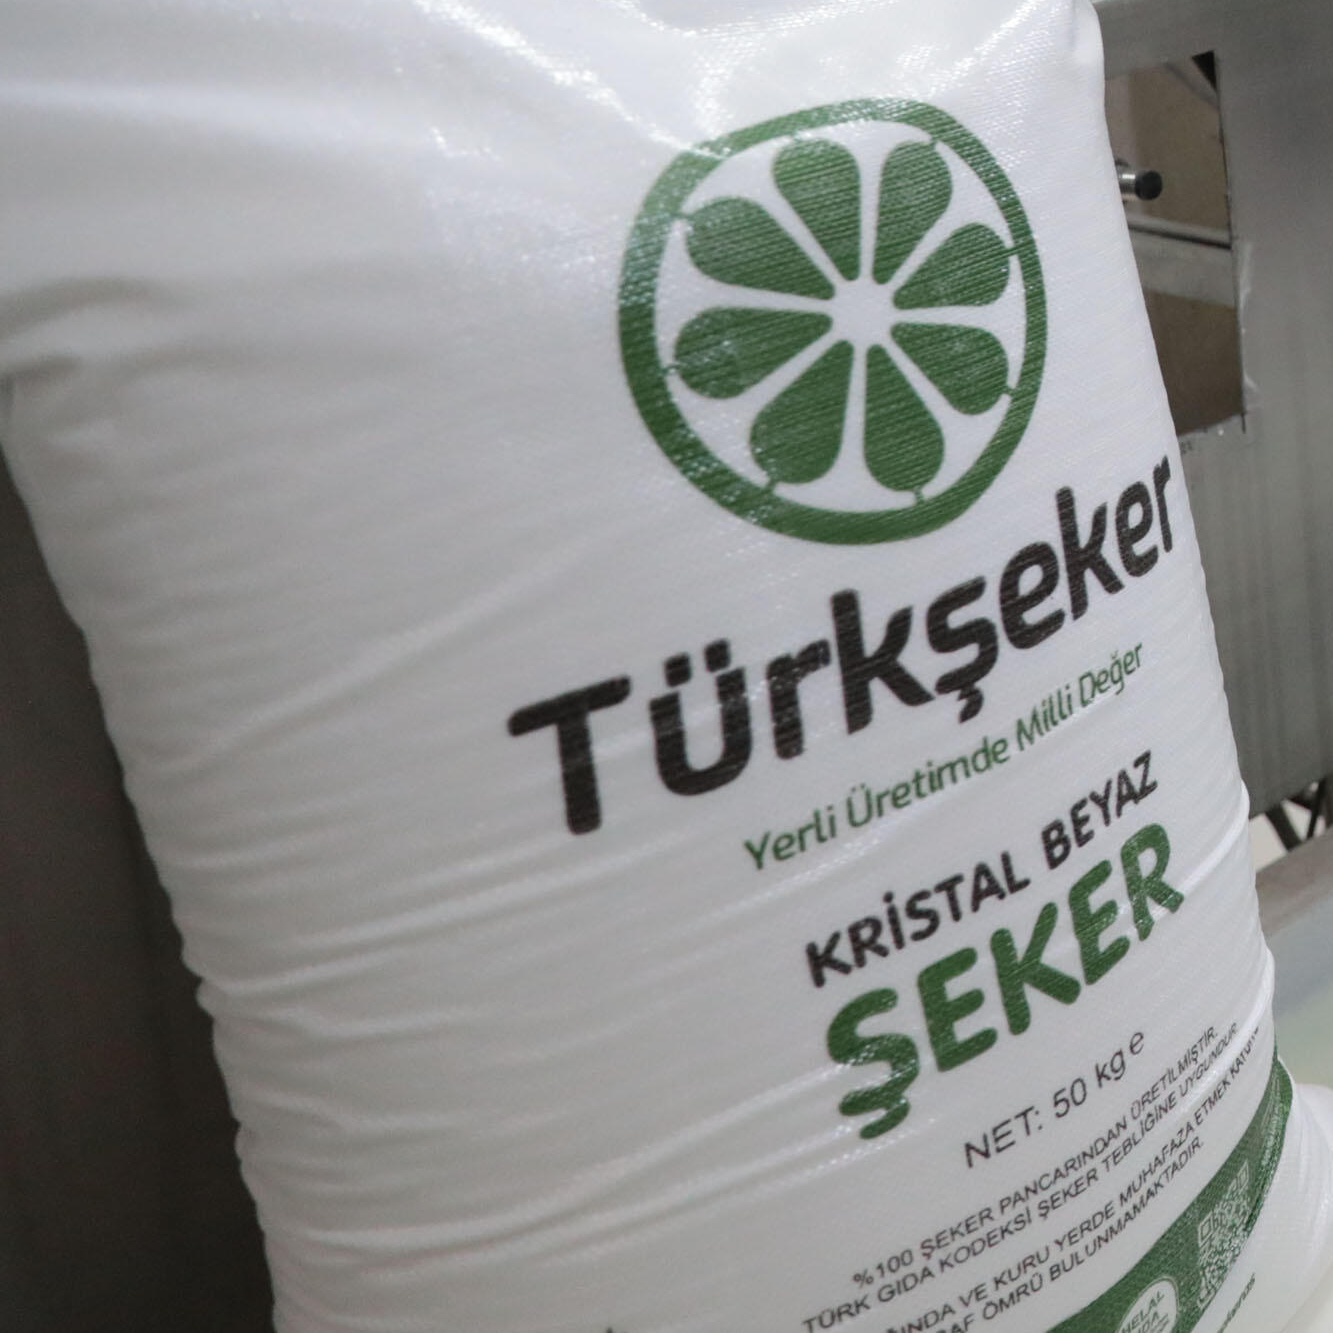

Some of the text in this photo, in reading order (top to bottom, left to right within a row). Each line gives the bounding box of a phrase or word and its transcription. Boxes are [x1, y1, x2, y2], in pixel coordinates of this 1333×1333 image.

[507, 456, 1173, 833] Türkşeker
[744, 642, 1146, 871] Yerli Üretimde Milli Değer
[804, 750, 1158, 988] KRİSTAL BEYAZ
[826, 822, 1184, 1140] ŞEKER
[803, 1294, 872, 1333] TÜRK
[877, 1265, 936, 1304] GIDA
[938, 1210, 1034, 1273] KODEKSİ
[1037, 1167, 1100, 1220] ŞEKER
[1101, 1090, 1179, 1172] TEBLİĞİNE
[920, 1206, 995, 1260] ŞEKER
[999, 1115, 1127, 1215] PANCARINDAN
[1129, 1025, 1219, 1122] ÜRETİLMİŞTİR.
[959, 1281, 989, 1308] VE
[992, 1247, 1050, 1293] KURU
[1053, 1200, 1116, 1252] YERDE
[1119, 1121, 1196, 1208] MUHAFAZA
[1193, 1075, 1233, 1126] ETMEK
[963, 1104, 1045, 1168] NET:
[1052, 1077, 1089, 1119] 50
[1094, 1049, 1127, 1088] kg
[982, 1272, 1044, 1321] ÖMRÜ
